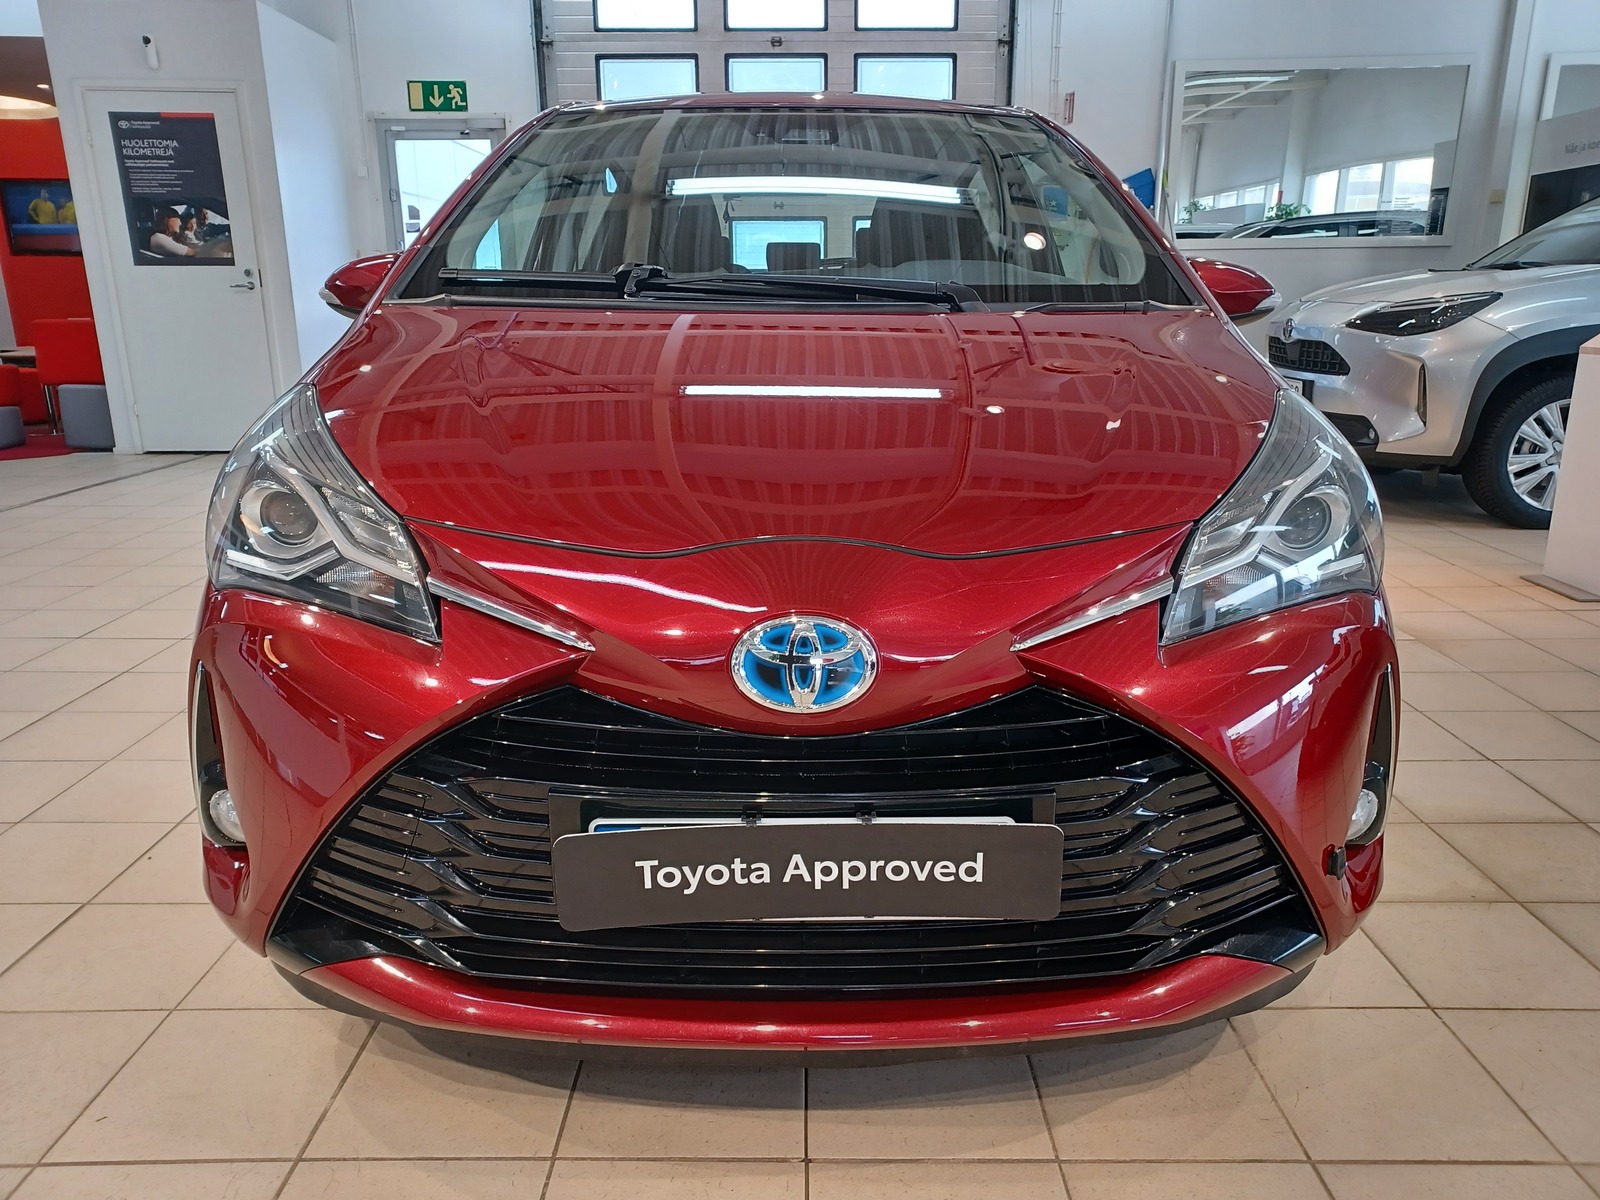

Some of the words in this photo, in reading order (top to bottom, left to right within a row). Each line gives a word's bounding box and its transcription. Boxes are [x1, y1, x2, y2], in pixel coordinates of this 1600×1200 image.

[121, 139, 178, 147] HUOLETTOMIA
[122, 147, 174, 156] KILOMETREJÄ
[635, 857, 770, 895] Toyota
[782, 852, 984, 889] Approved
